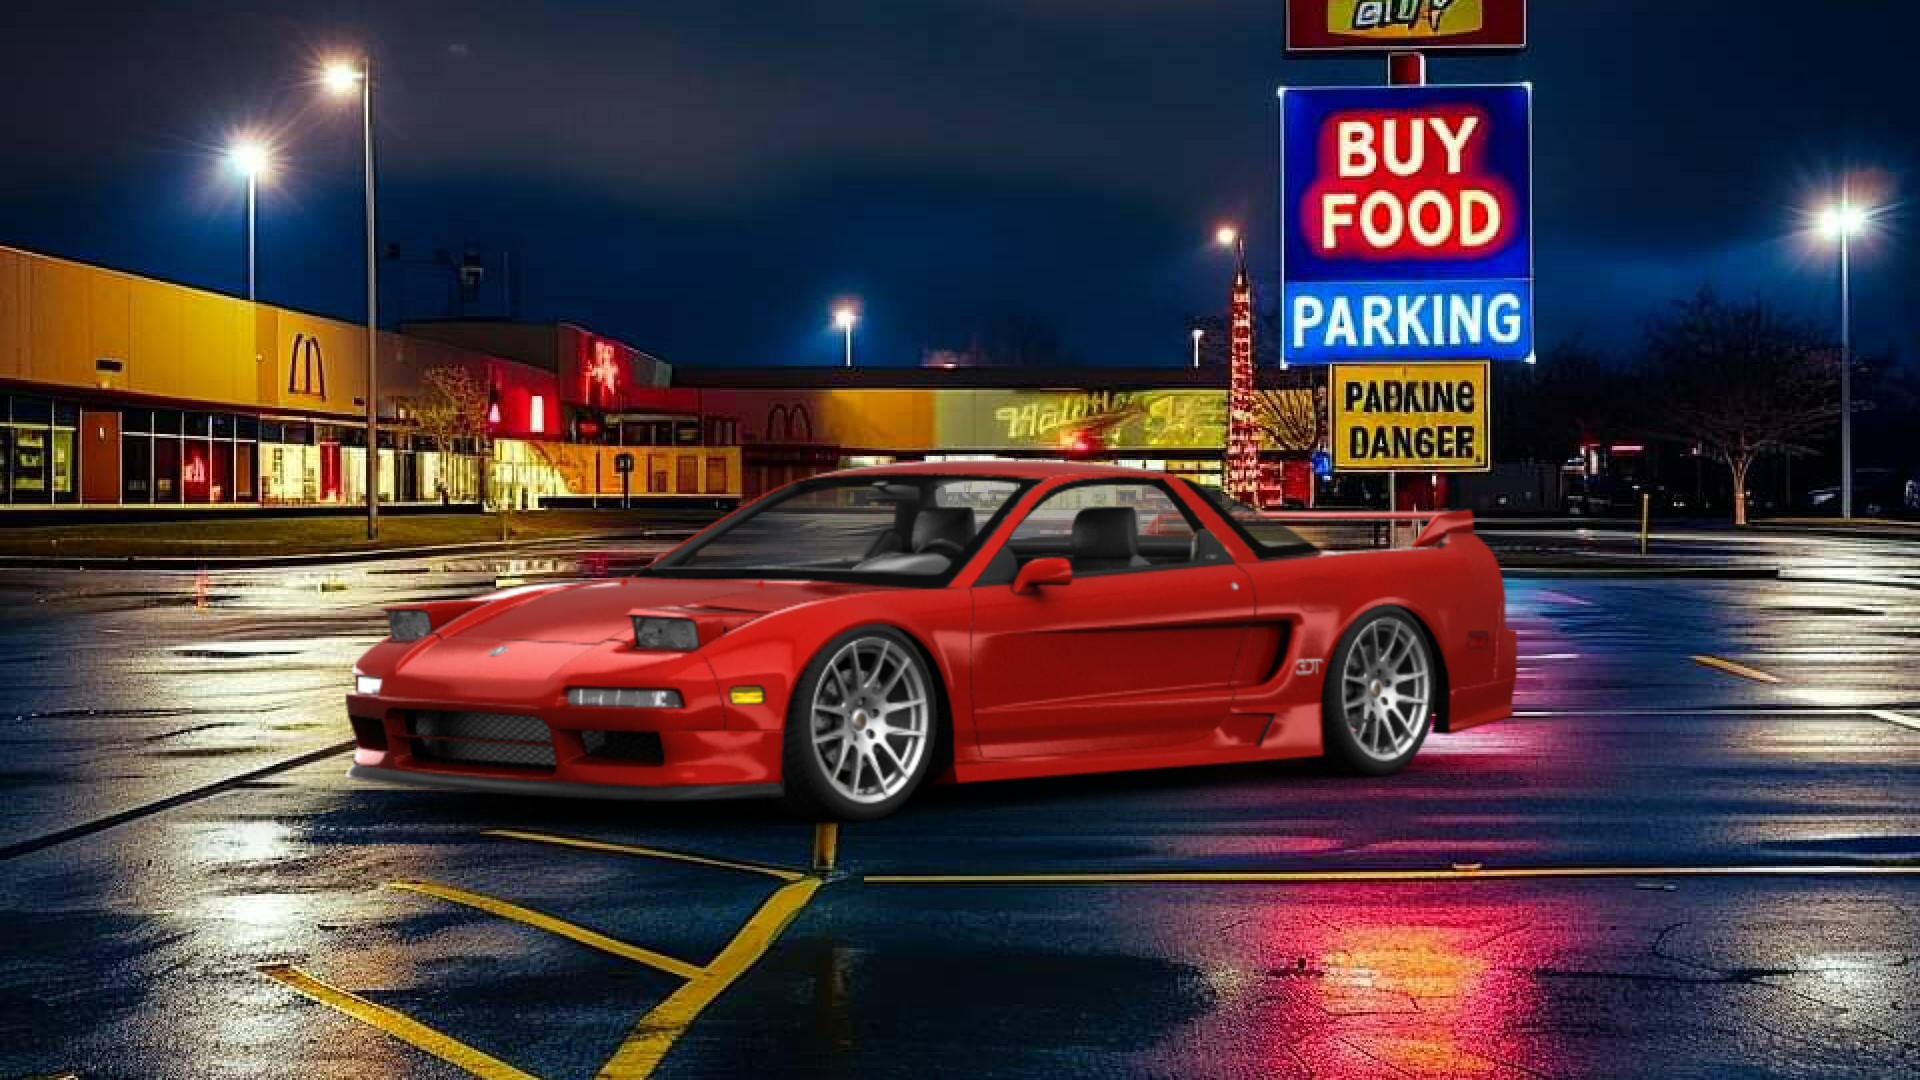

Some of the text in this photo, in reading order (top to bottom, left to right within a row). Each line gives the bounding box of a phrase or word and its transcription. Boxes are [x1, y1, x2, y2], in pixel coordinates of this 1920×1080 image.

[1338, 116, 1479, 177] BUY
[1321, 190, 1500, 249] FOOD
[1293, 293, 1520, 348] PARKING
